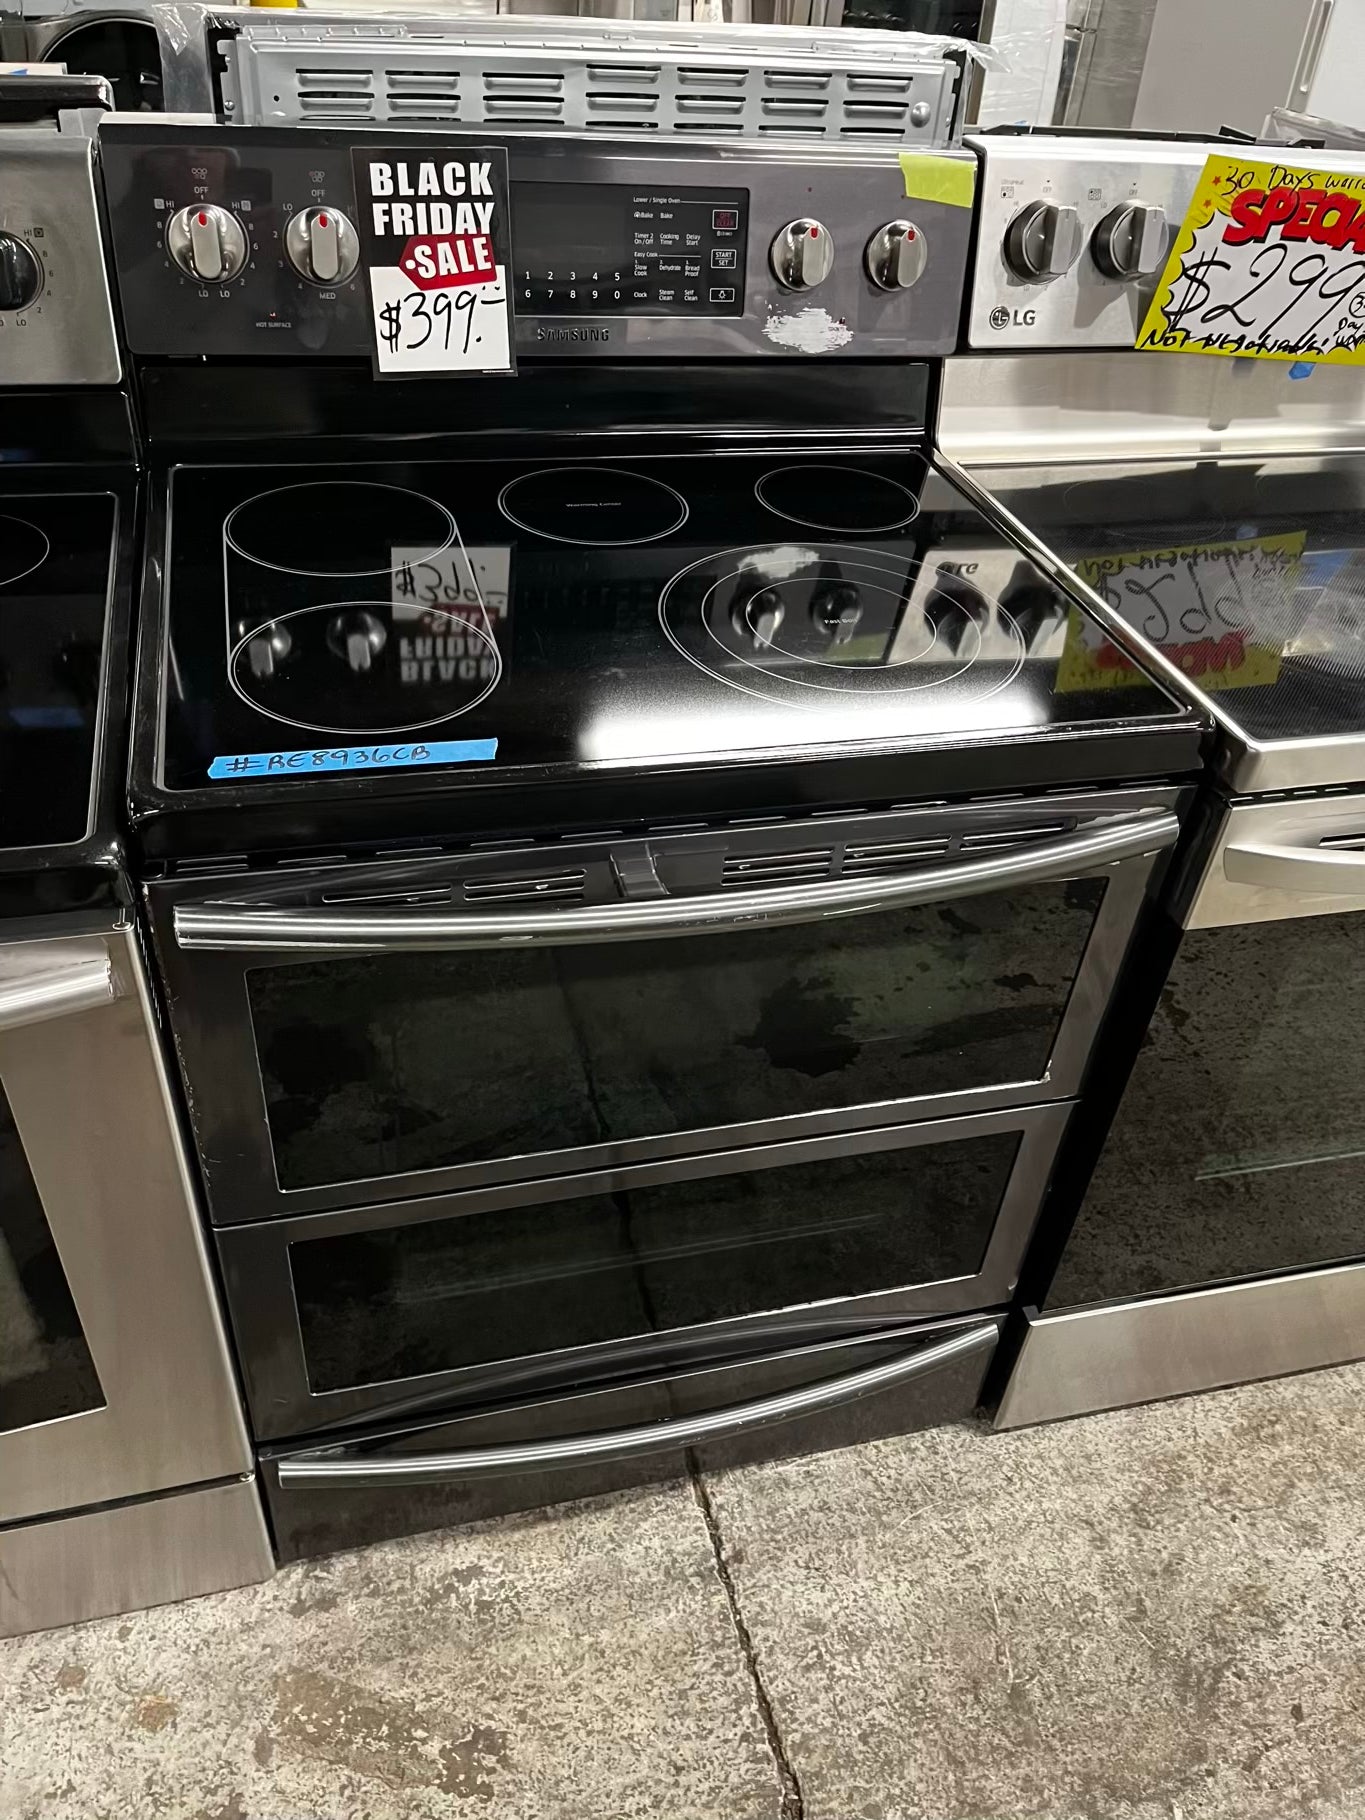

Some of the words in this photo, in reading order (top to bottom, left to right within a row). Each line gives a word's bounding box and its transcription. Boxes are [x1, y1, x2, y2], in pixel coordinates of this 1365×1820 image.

[369, 162, 494, 196] BLACK
[1221, 166, 1255, 196] 30
[1267, 164, 1322, 197] Days
[194, 186, 209, 194] OFF
[311, 189, 326, 197] OFF
[283, 203, 293, 211] LO
[372, 202, 495, 236] FRIDAY
[413, 237, 492, 279] SALE
[525, 271, 531, 280] 1
[547, 271, 554, 280] 2
[570, 271, 576, 280] 3
[592, 272, 598, 281] 4
[614, 272, 620, 281] 5
[219, 290, 231, 298] LO
[319, 292, 336, 300] MED
[525, 289, 531, 298] 6
[547, 289, 554, 299] 7
[570, 289, 576, 299] 8
[592, 290, 598, 299] 9
[614, 290, 620, 300] 0
[1013, 309, 1036, 326] LG
[16, 319, 27, 327] LO
[537, 327, 609, 342] SAMSUNG
